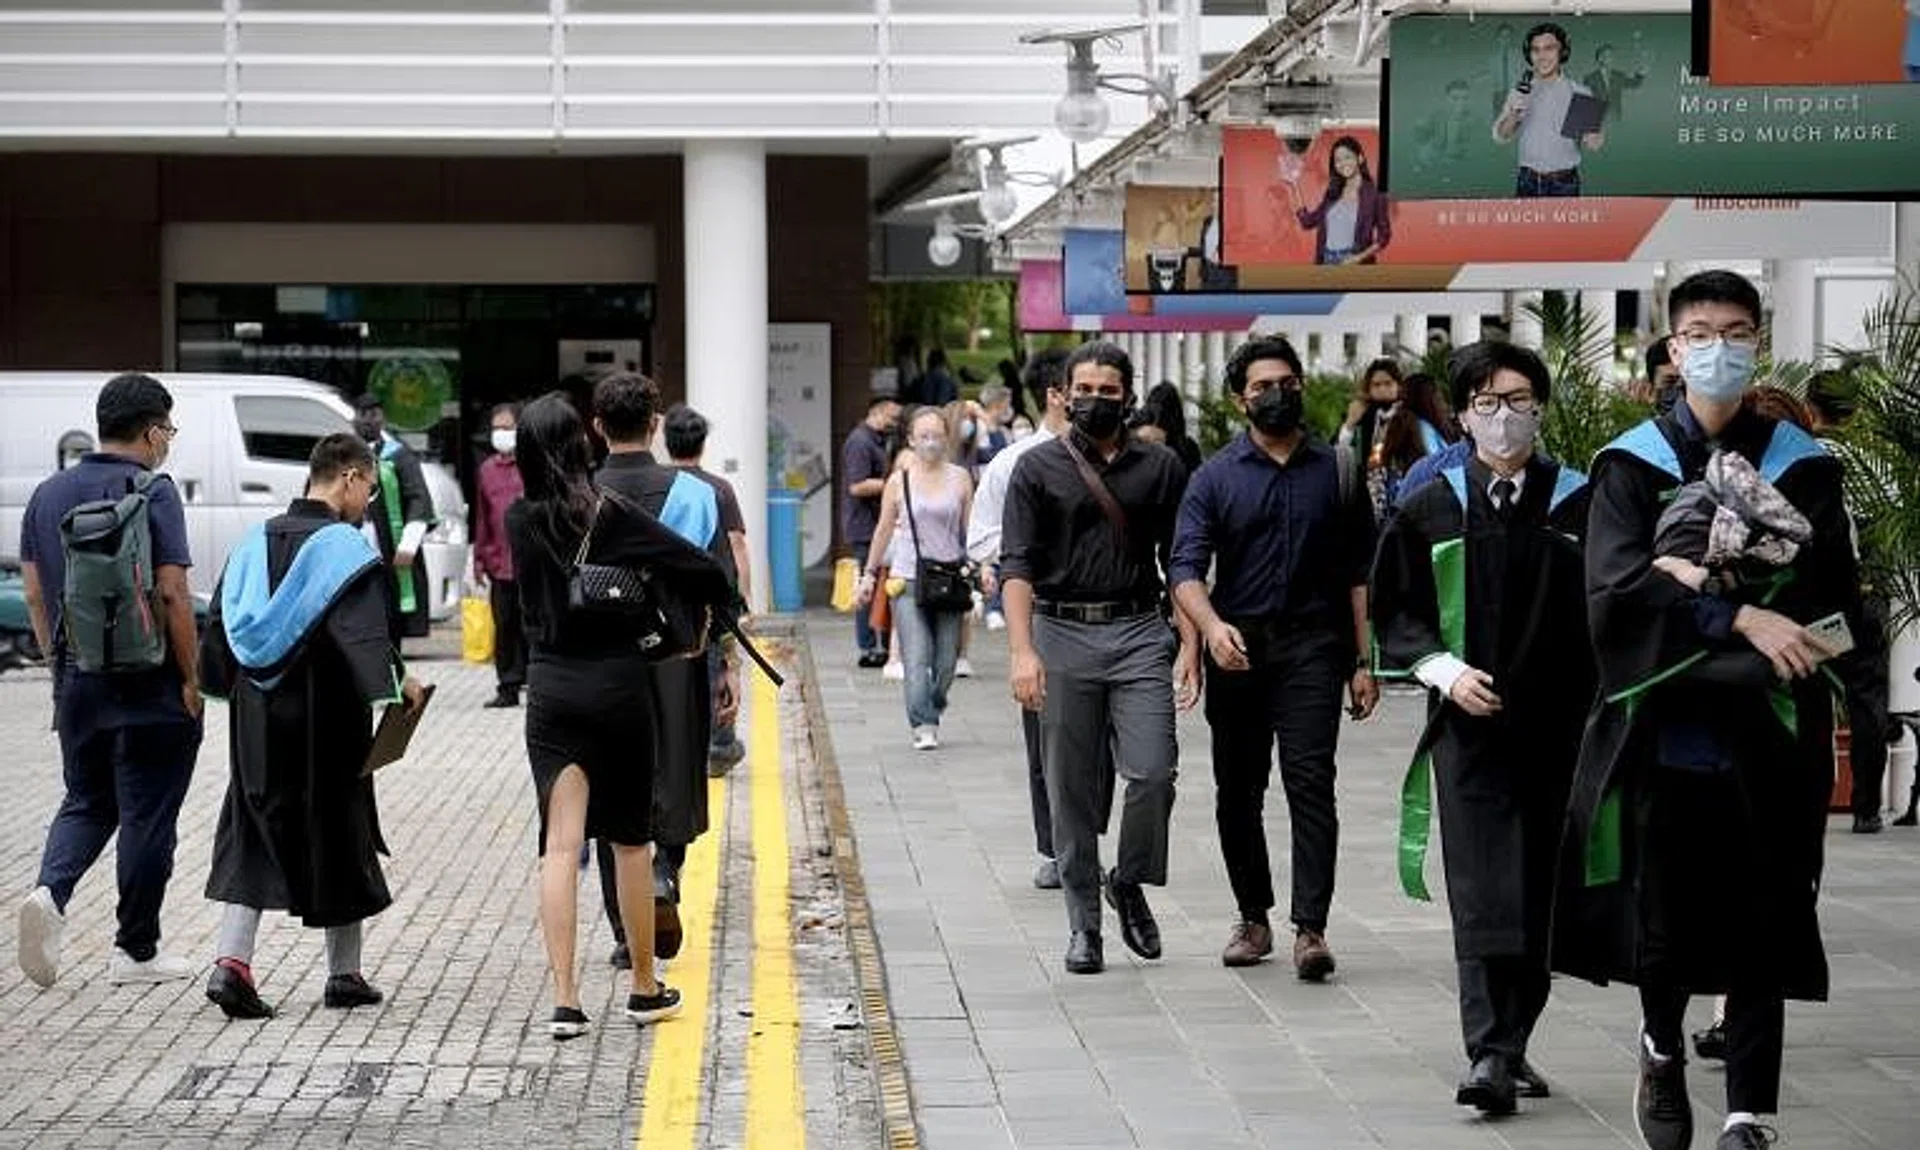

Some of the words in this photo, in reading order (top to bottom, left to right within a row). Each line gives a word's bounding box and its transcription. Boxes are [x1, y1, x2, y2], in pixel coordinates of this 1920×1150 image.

[1680, 95, 1748, 113] More
[1763, 93, 1859, 114] Impact
[1678, 127, 1706, 143] BE
[1716, 127, 1745, 143] SO
[1756, 125, 1822, 142] MUCH
[1833, 123, 1898, 140] MORE
[1496, 209, 1545, 223] MUCH
[1552, 209, 1601, 223] MORE
